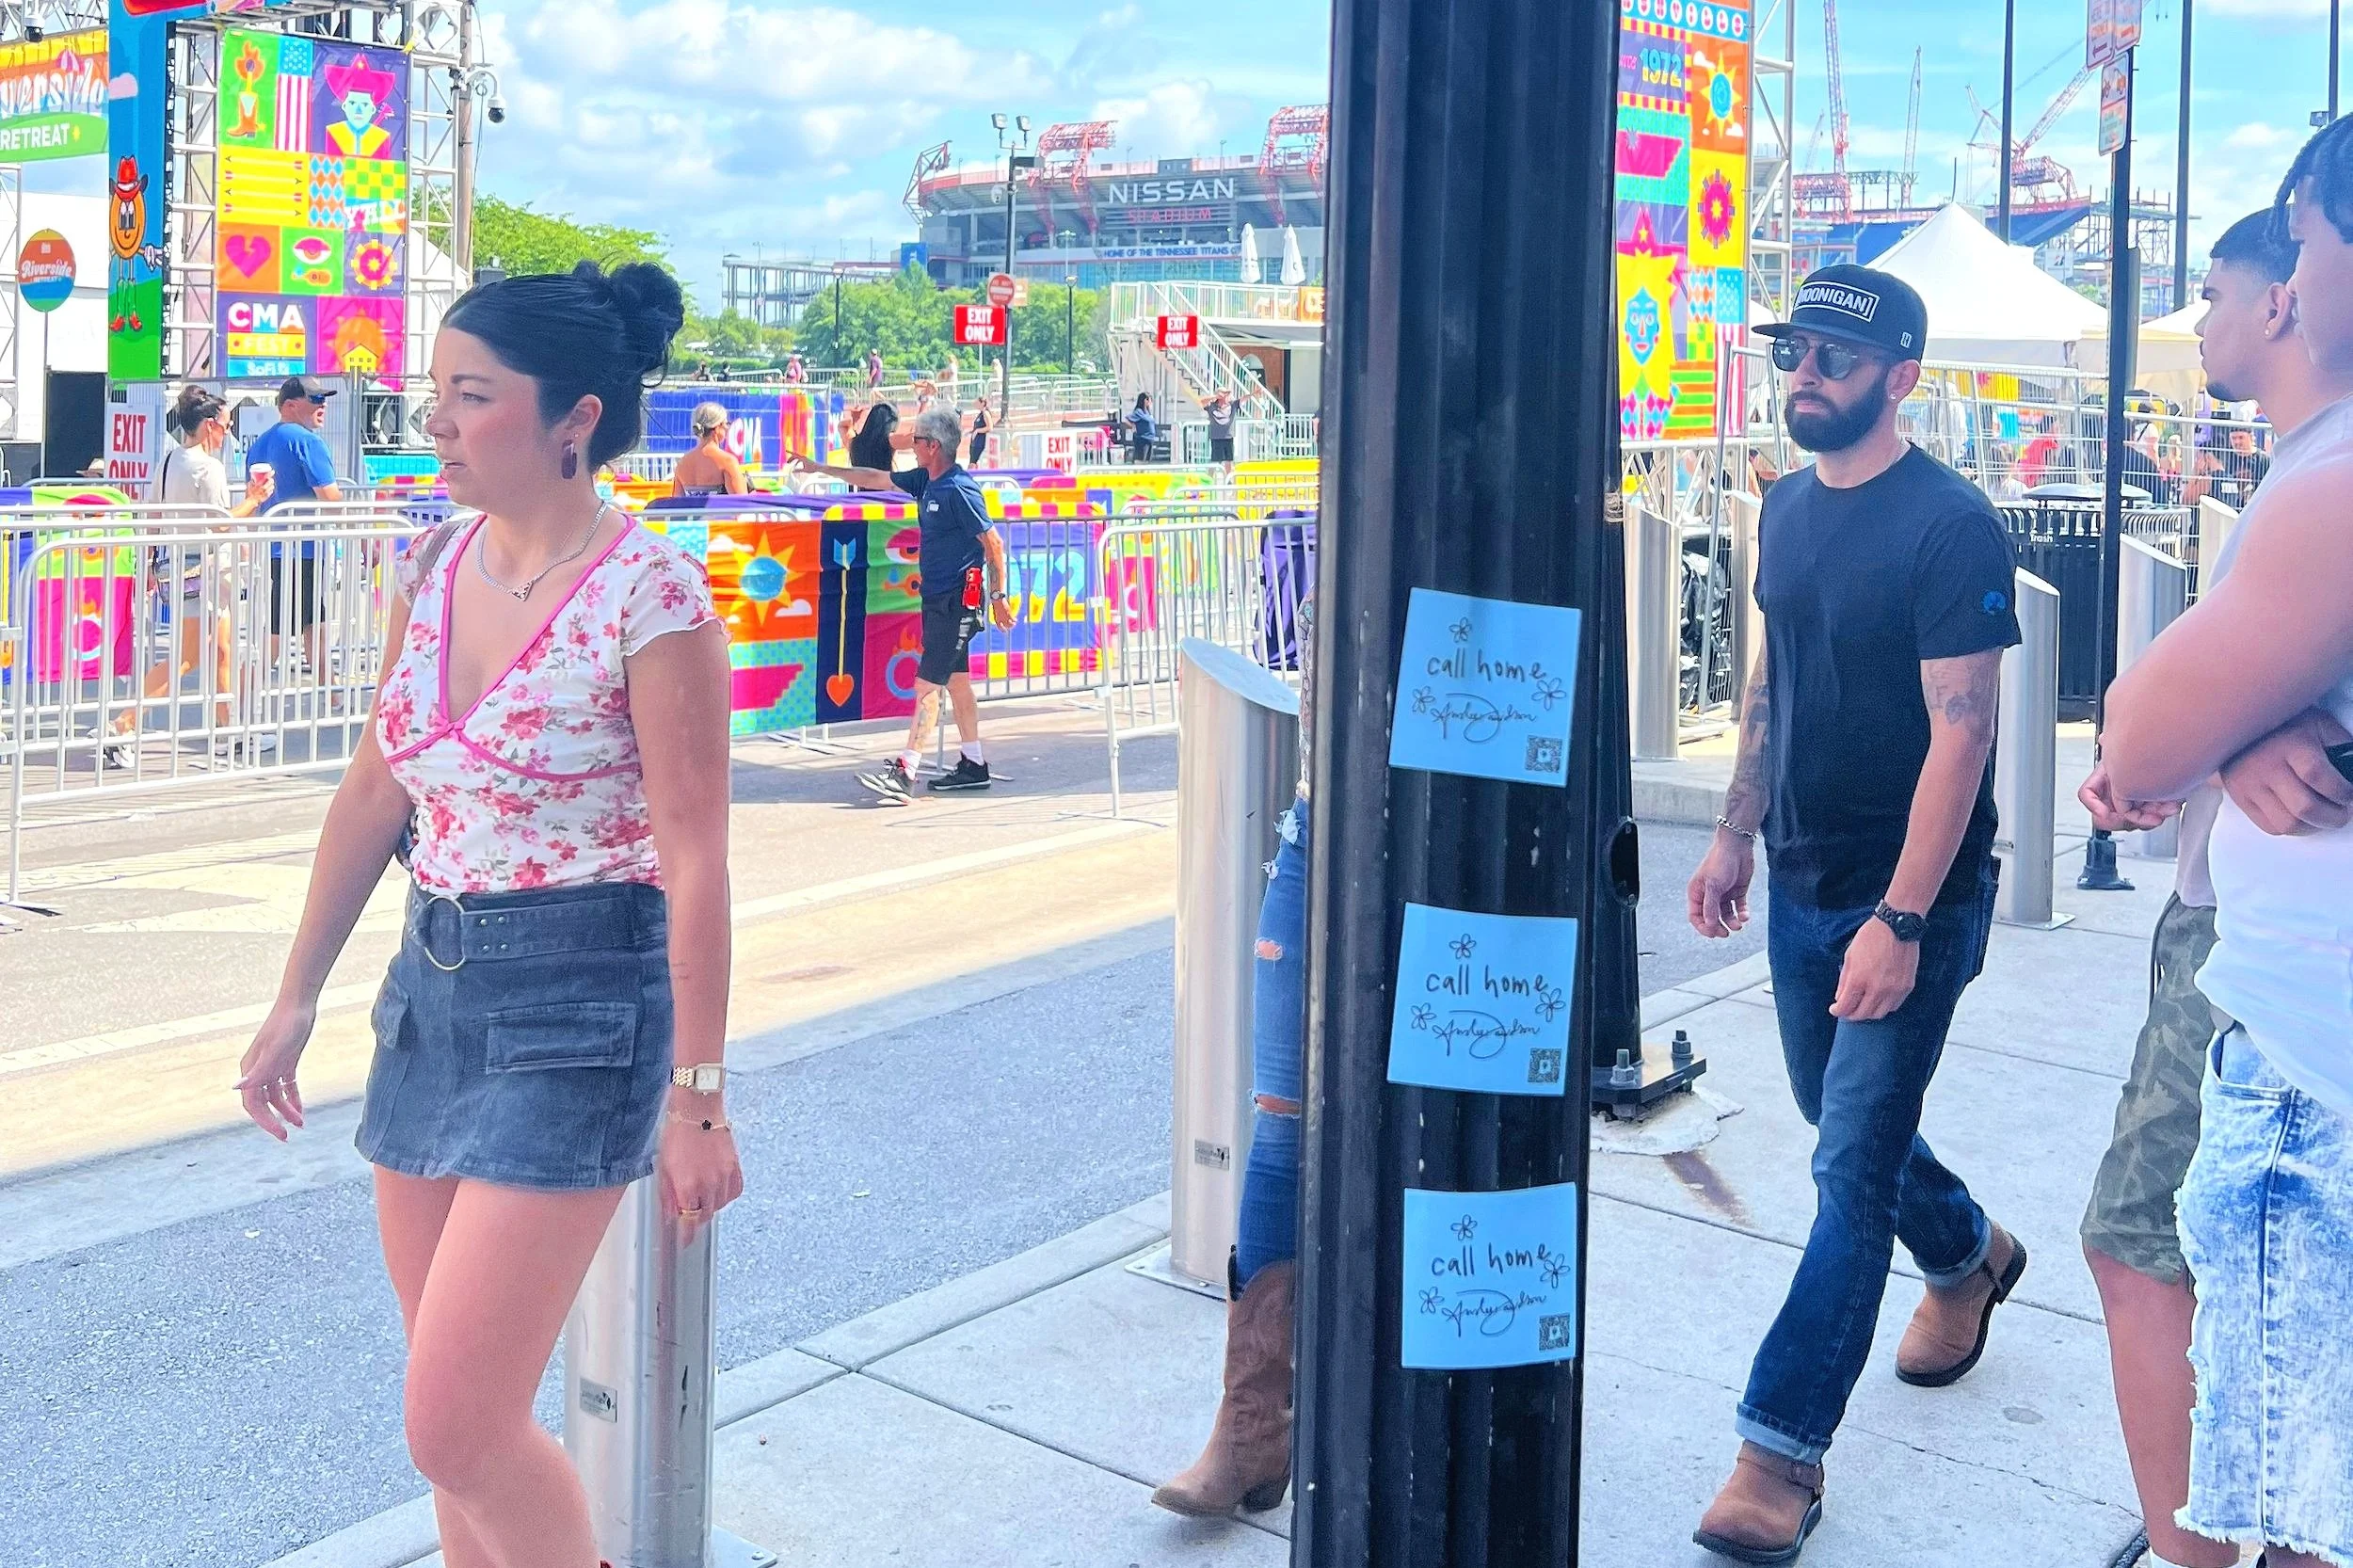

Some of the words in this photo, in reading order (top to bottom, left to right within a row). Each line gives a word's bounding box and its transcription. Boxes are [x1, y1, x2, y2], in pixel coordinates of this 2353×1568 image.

[1640, 48, 1682, 88] 1972
[0, 123, 70, 151] RETREAT
[1109, 178, 1234, 203] NISSAN
[1128, 208, 1211, 223] STADIUM
[1104, 249, 1124, 258] HOME
[1127, 248, 1138, 257] OF
[1140, 248, 1153, 257] THE
[1156, 247, 1198, 256] TENNESSEE
[1201, 246, 1229, 255] TITANS
[22, 259, 72, 279] Riverside
[229, 302, 305, 329] CMA
[968, 308, 993, 324] EXIT
[1167, 316, 1188, 330] EXIT
[965, 325, 995, 342] ONLY
[1165, 331, 1190, 346] ONLY
[244, 336, 287, 354] FEST
[113, 413, 146, 453] EXIT
[1048, 437, 1070, 454] EXIT
[1046, 457, 1072, 473] ONLY
[1427, 648, 1465, 678] call
[1477, 649, 1546, 681] home
[1426, 965, 1469, 995] call
[1484, 965, 1548, 998] home
[1432, 1244, 1475, 1276] call
[1488, 1242, 1551, 1273] home
